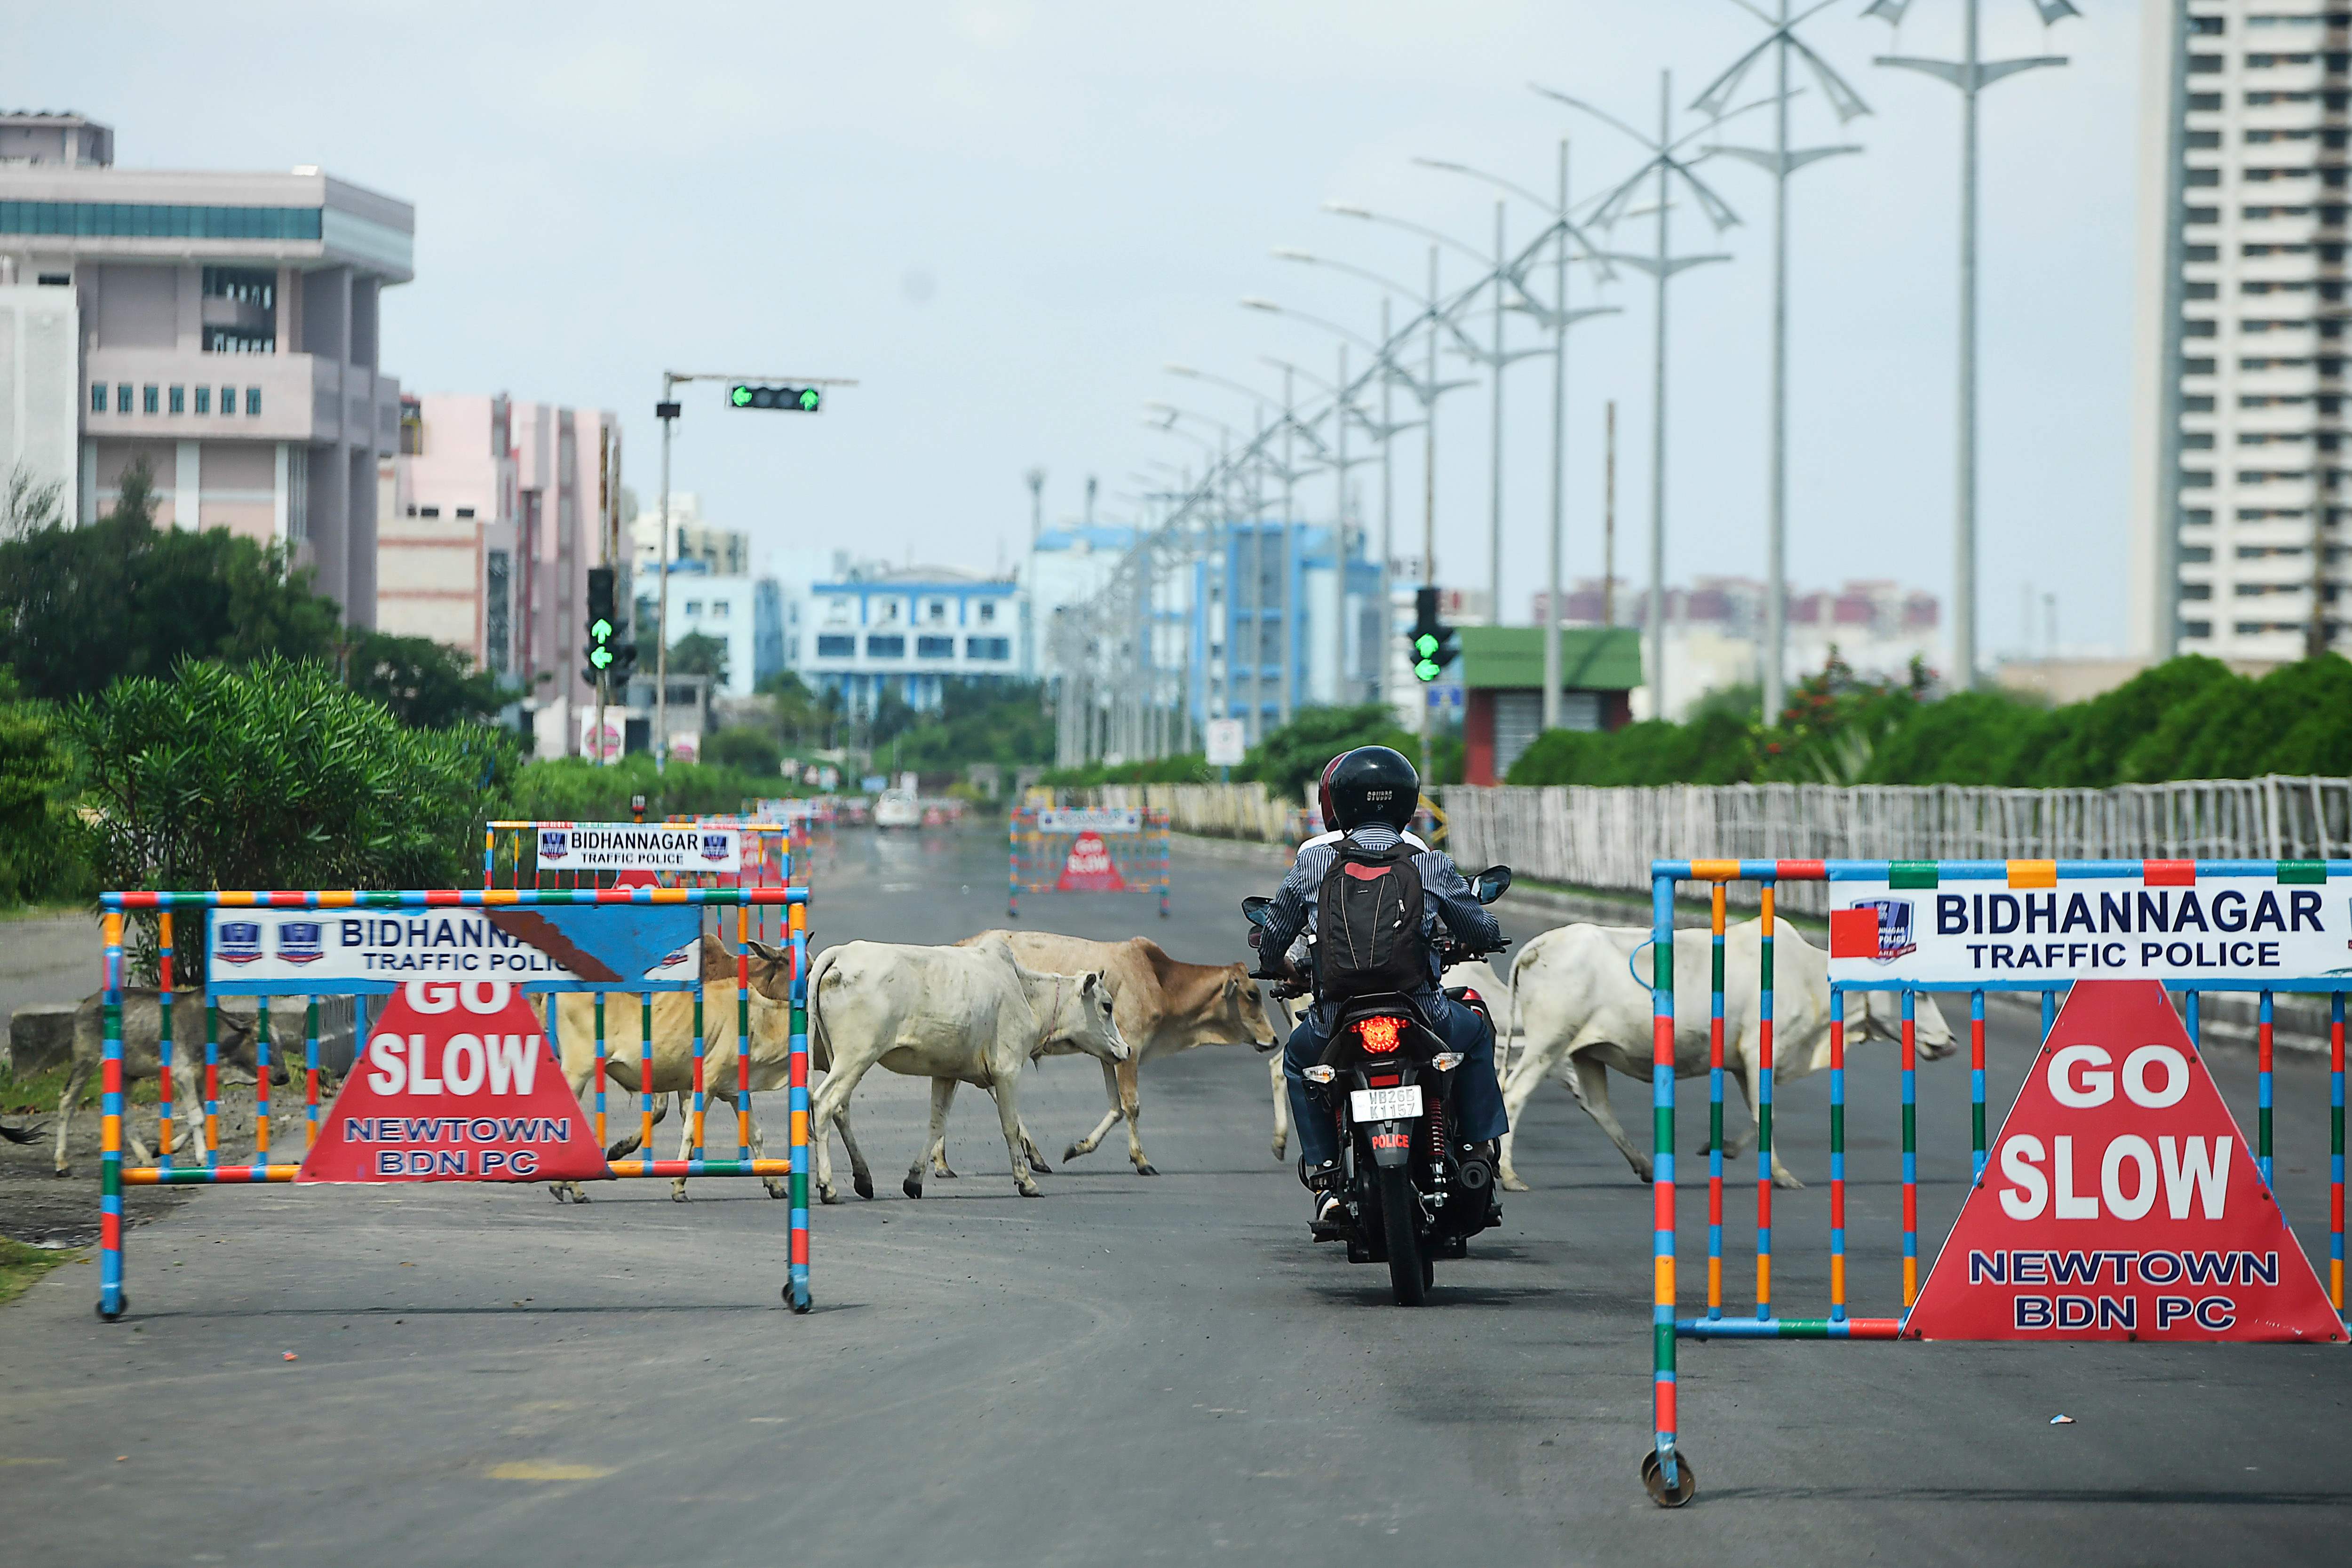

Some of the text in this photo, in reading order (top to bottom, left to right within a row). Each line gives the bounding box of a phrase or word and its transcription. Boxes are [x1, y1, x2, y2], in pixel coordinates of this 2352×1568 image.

[572, 832, 698, 850] BIDHANNAGAR
[581, 852, 683, 865] TRAFFIC POLICE
[1937, 890, 2325, 935] BIDHANNAGAR
[361, 953, 478, 971] TRAFFIC
[1966, 941, 2280, 969] TRAFFIC POLICE
[405, 981, 511, 1014] GO
[367, 1033, 540, 1096] SLOW
[2047, 1044, 2190, 1108] GO
[1370, 1103, 1415, 1119] K1157
[343, 1117, 571, 1143] NEWTOWN
[1372, 1134, 1409, 1150] POLICE
[376, 1149, 539, 1175] BDN PC
[1998, 1134, 2233, 1221] SLOW
[1968, 1250, 2279, 1286] NEWTOWN
[2014, 1295, 2236, 1331] BDN PC
